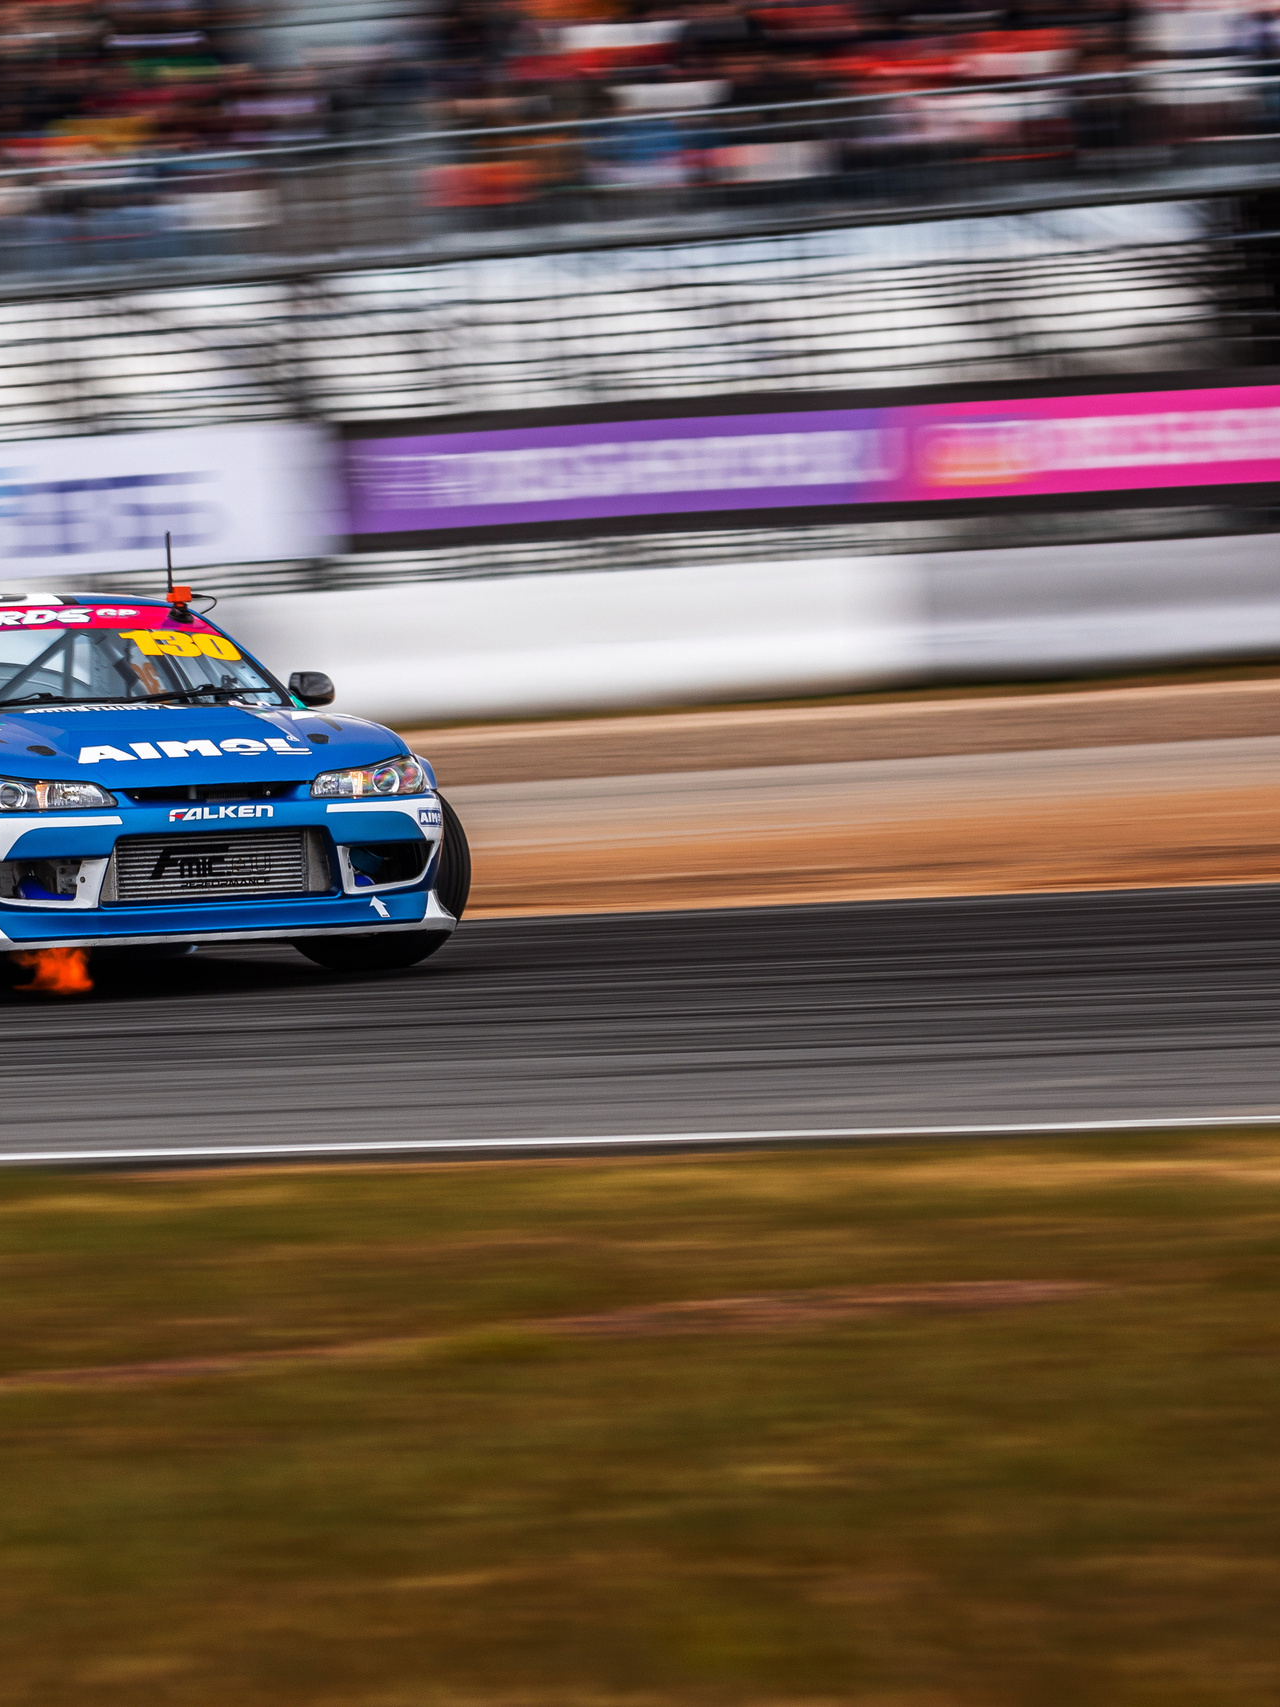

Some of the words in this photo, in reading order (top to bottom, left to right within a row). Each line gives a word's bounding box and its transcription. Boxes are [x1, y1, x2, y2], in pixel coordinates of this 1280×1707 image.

[95, 608, 138, 618] GP
[118, 630, 242, 661] 130
[78, 738, 312, 765] AIMOL
[167, 804, 274, 822] FALKEN
